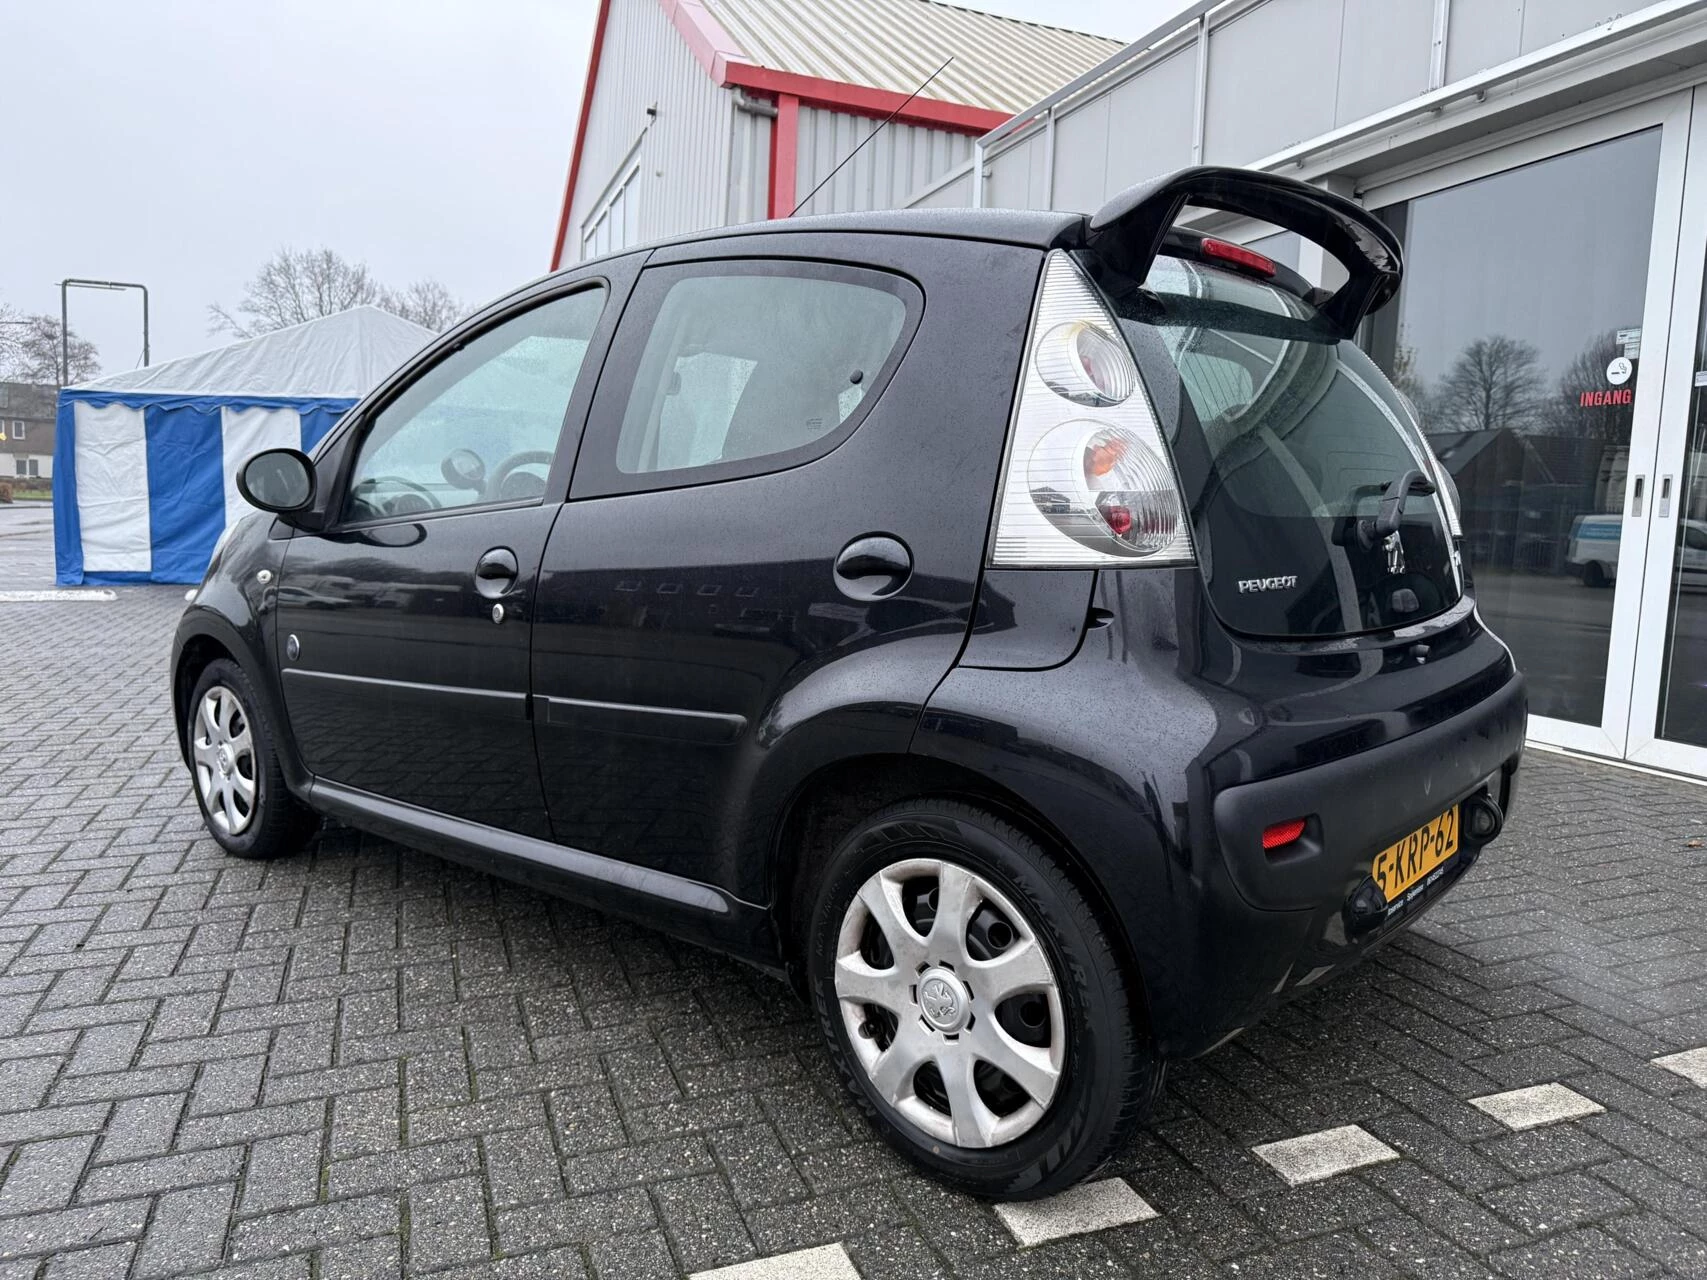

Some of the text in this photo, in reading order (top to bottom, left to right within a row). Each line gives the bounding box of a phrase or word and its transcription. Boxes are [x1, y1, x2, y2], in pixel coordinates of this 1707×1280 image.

[1580, 389, 1632, 407] INGANG
[1238, 575, 1298, 594] PEUGEOT
[1376, 808, 1454, 892] 5-KRP-62
